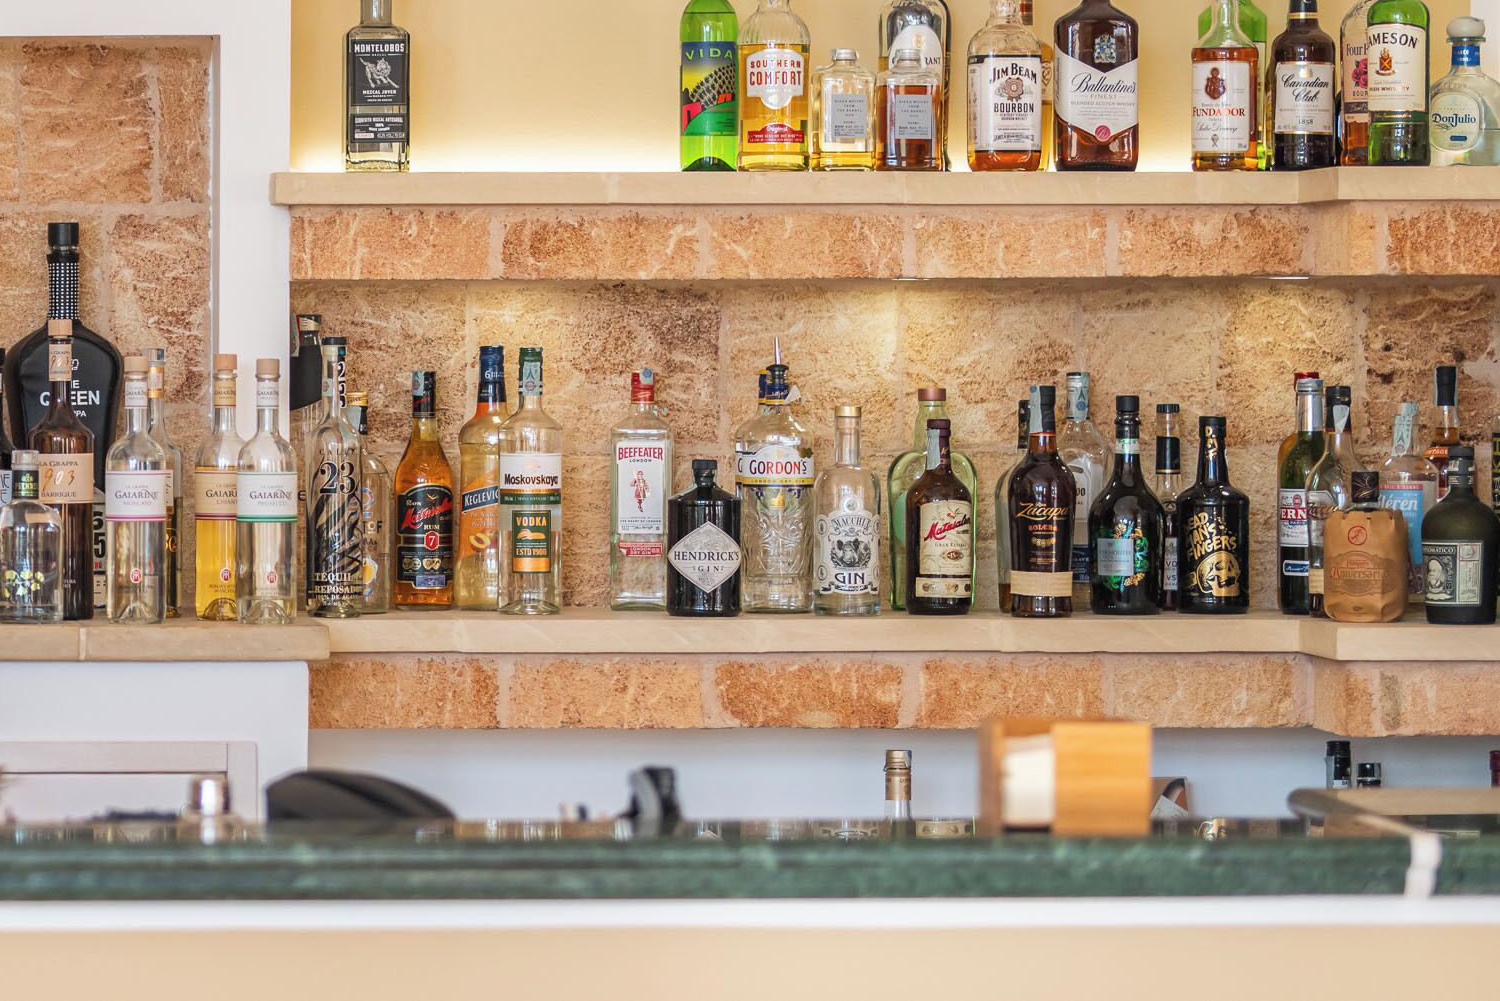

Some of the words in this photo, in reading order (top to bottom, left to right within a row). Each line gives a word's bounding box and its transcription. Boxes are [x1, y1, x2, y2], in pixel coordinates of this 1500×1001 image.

[354, 43, 404, 53] MONTELOBOS
[685, 48, 733, 60] VIDA
[1346, 44, 1364, 56] Four
[750, 59, 801, 69] SOUTHERN
[750, 71, 801, 86] COMFORT
[989, 66, 1009, 84] JIM
[1011, 62, 1037, 85] BEAM
[1071, 74, 1137, 95] Ballantine's
[1281, 74, 1329, 89] Canadian
[1292, 88, 1319, 103] Club
[994, 102, 1034, 113] BOURBON
[1192, 106, 1246, 118] FUNDADOR
[40, 391, 100, 406] QEEN
[618, 447, 663, 461] BEEFEATER
[750, 460, 807, 474] GORDON'S
[42, 468, 75, 491] 903
[319, 462, 355, 496] 23
[504, 473, 558, 488] Moskovskaya
[115, 489, 159, 499] GAIARINE
[250, 491, 293, 500] GAIARINE
[464, 490, 499, 506] KEGLEVIC
[1016, 502, 1068, 520] Zacapa
[516, 517, 547, 526] VODKA
[429, 535, 436, 546] 7
[674, 550, 739, 561] HENDRICK'S
[835, 572, 865, 584] GIN
